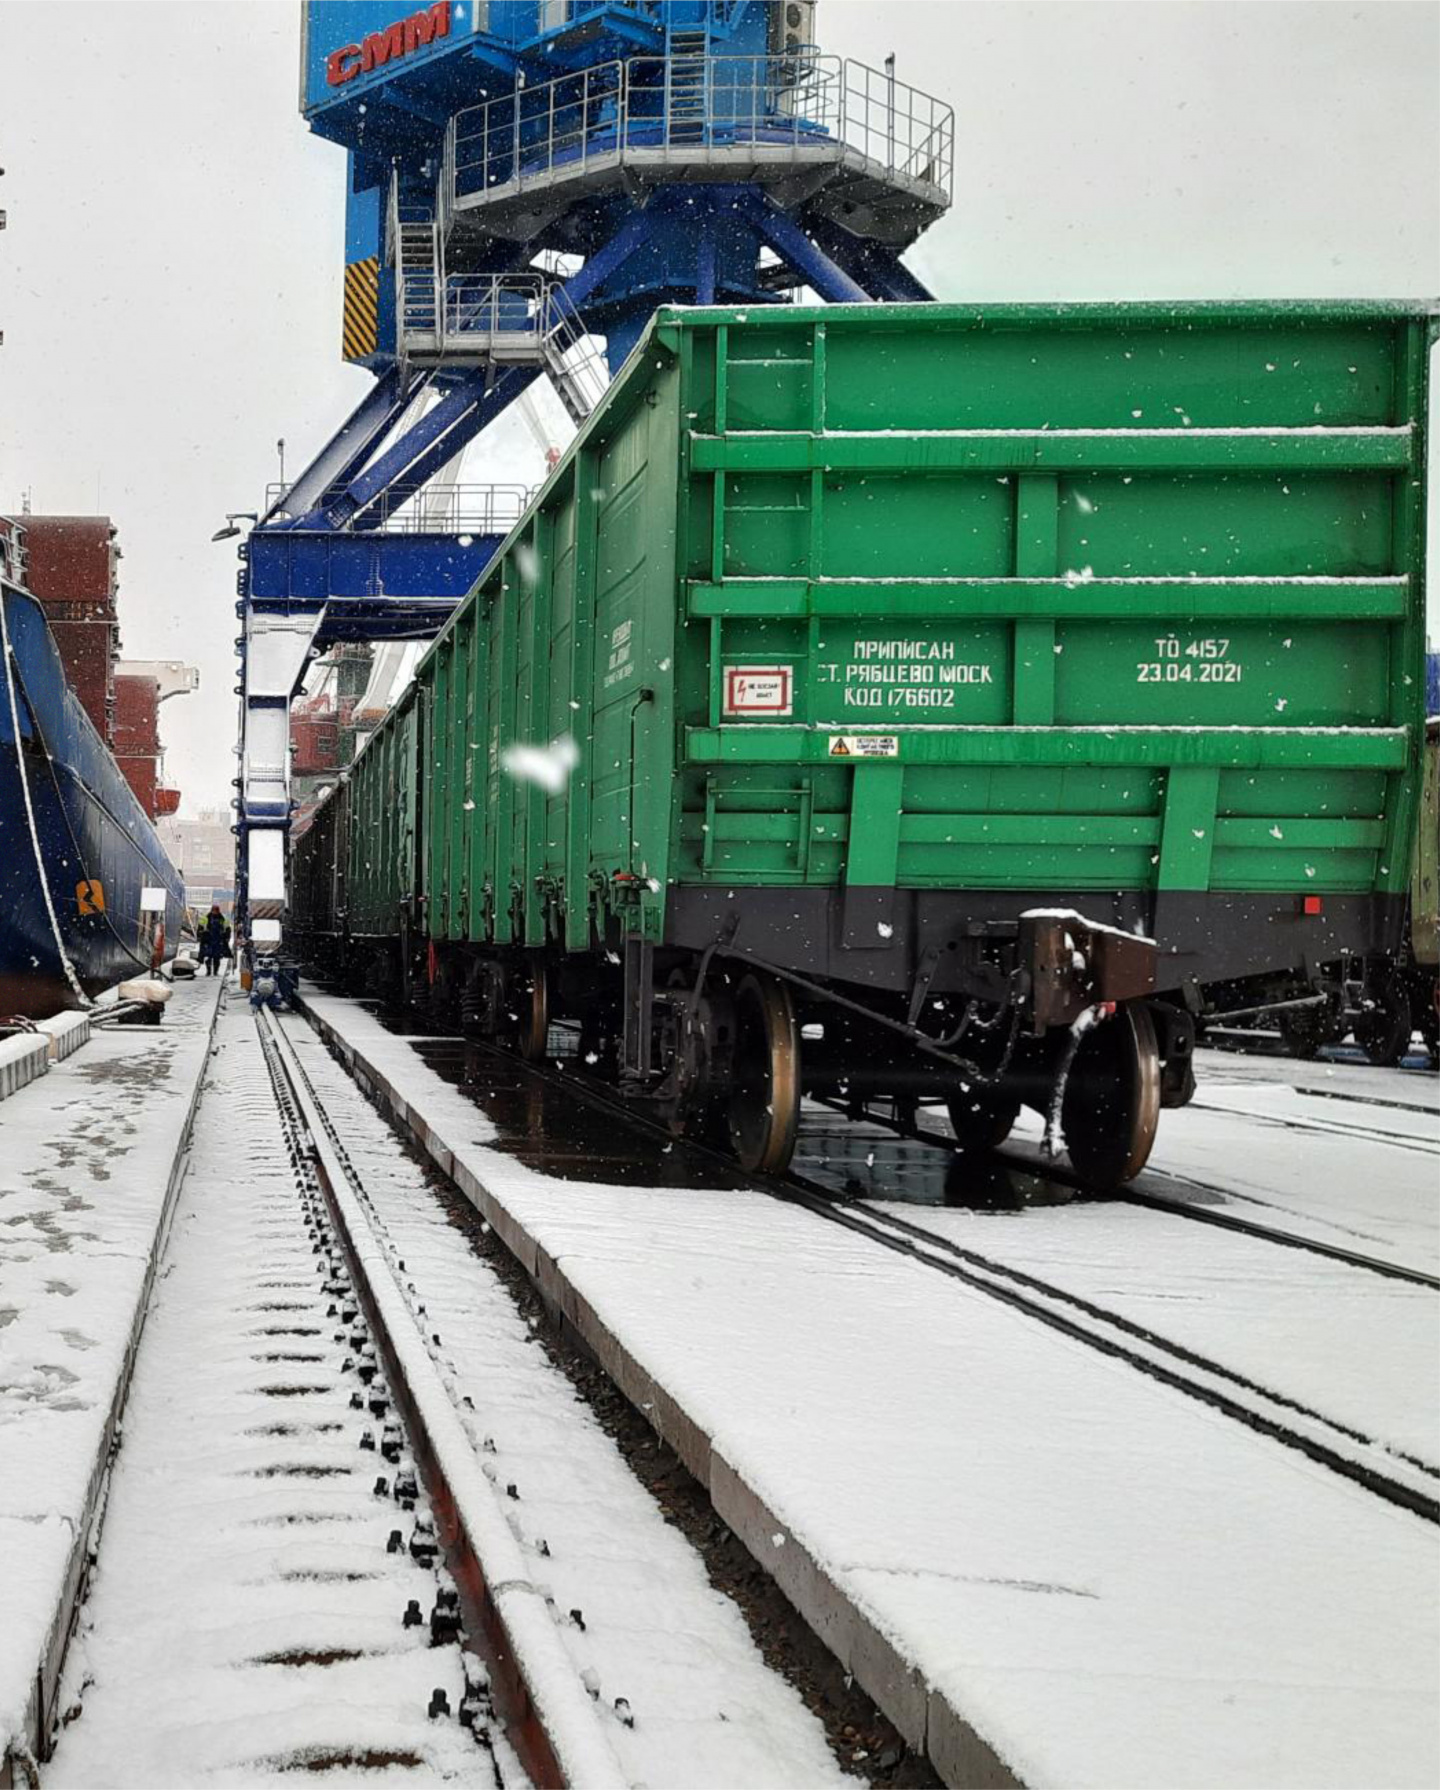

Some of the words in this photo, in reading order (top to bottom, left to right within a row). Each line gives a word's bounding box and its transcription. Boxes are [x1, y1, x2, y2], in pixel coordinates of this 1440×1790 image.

[853, 641, 955, 660] ПРИПИСАН
[1154, 639, 1180, 658] ТО
[1185, 640, 1230, 658] 4157
[846, 664, 935, 683] РЯБЦЕВО
[939, 664, 993, 683] МОСК
[1137, 663, 1241, 682] 23.04.2021
[844, 688, 883, 706] КОД
[888, 688, 955, 707] 176602
